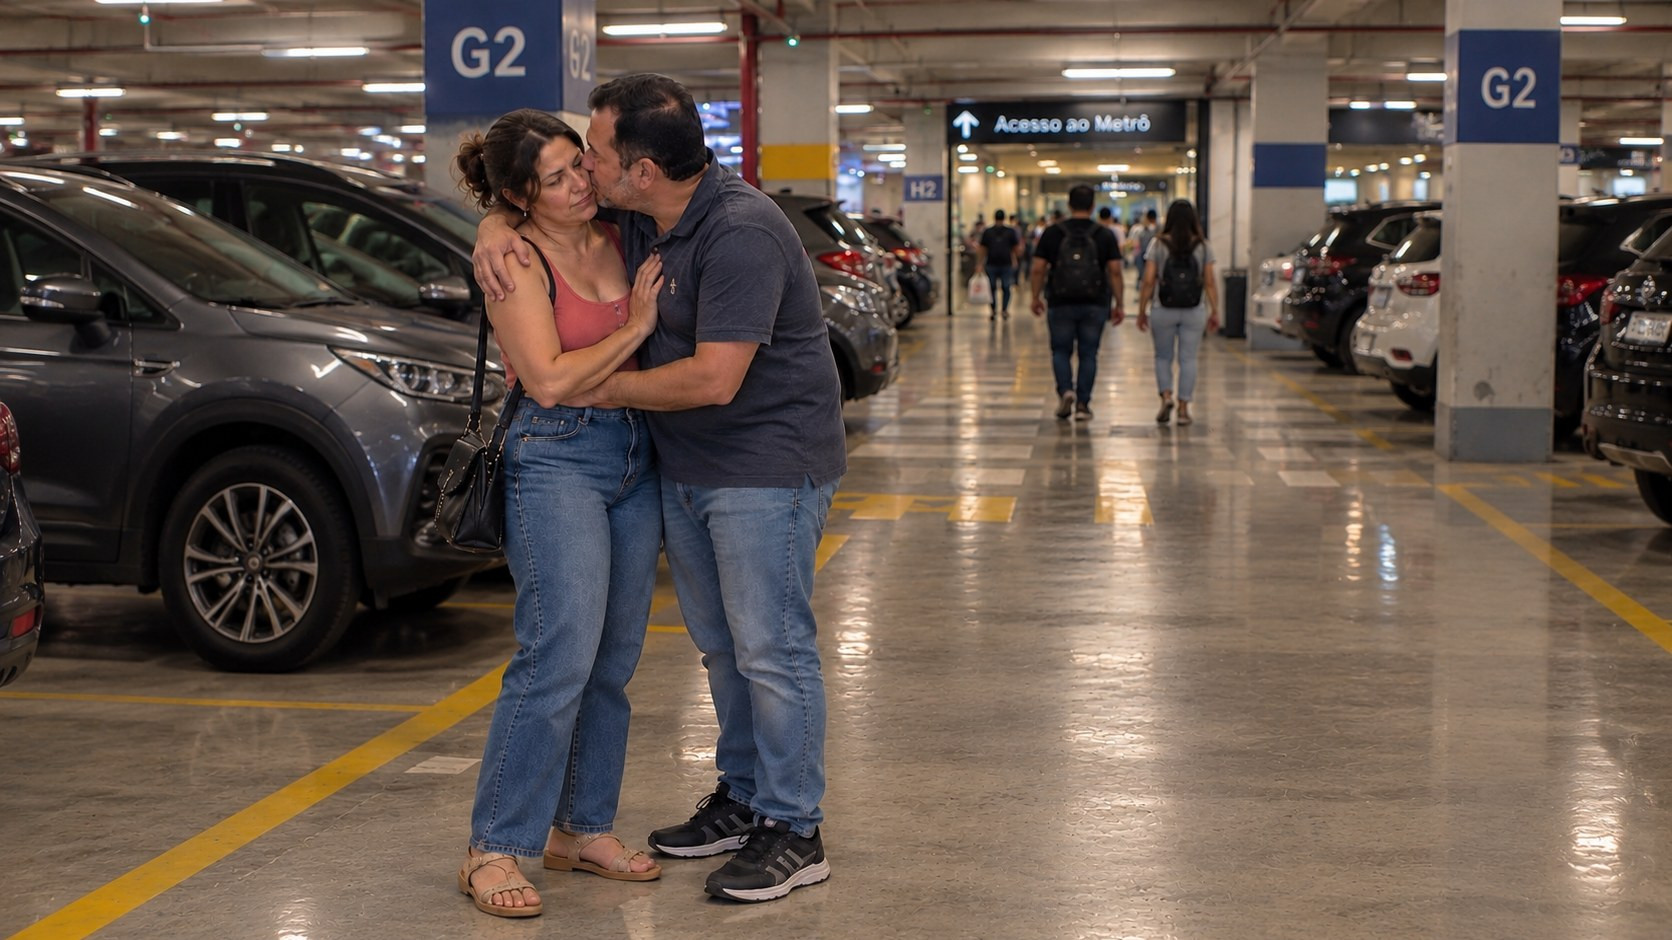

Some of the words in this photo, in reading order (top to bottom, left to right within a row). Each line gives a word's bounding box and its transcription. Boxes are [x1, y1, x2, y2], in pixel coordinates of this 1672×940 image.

[451, 26, 526, 78] G2
[569, 29, 592, 81] G2
[1482, 67, 1536, 108] G2
[994, 115, 1062, 133] Acesso
[1066, 118, 1090, 133] ao
[1094, 114, 1150, 133] Metrô
[911, 180, 937, 198] H2
